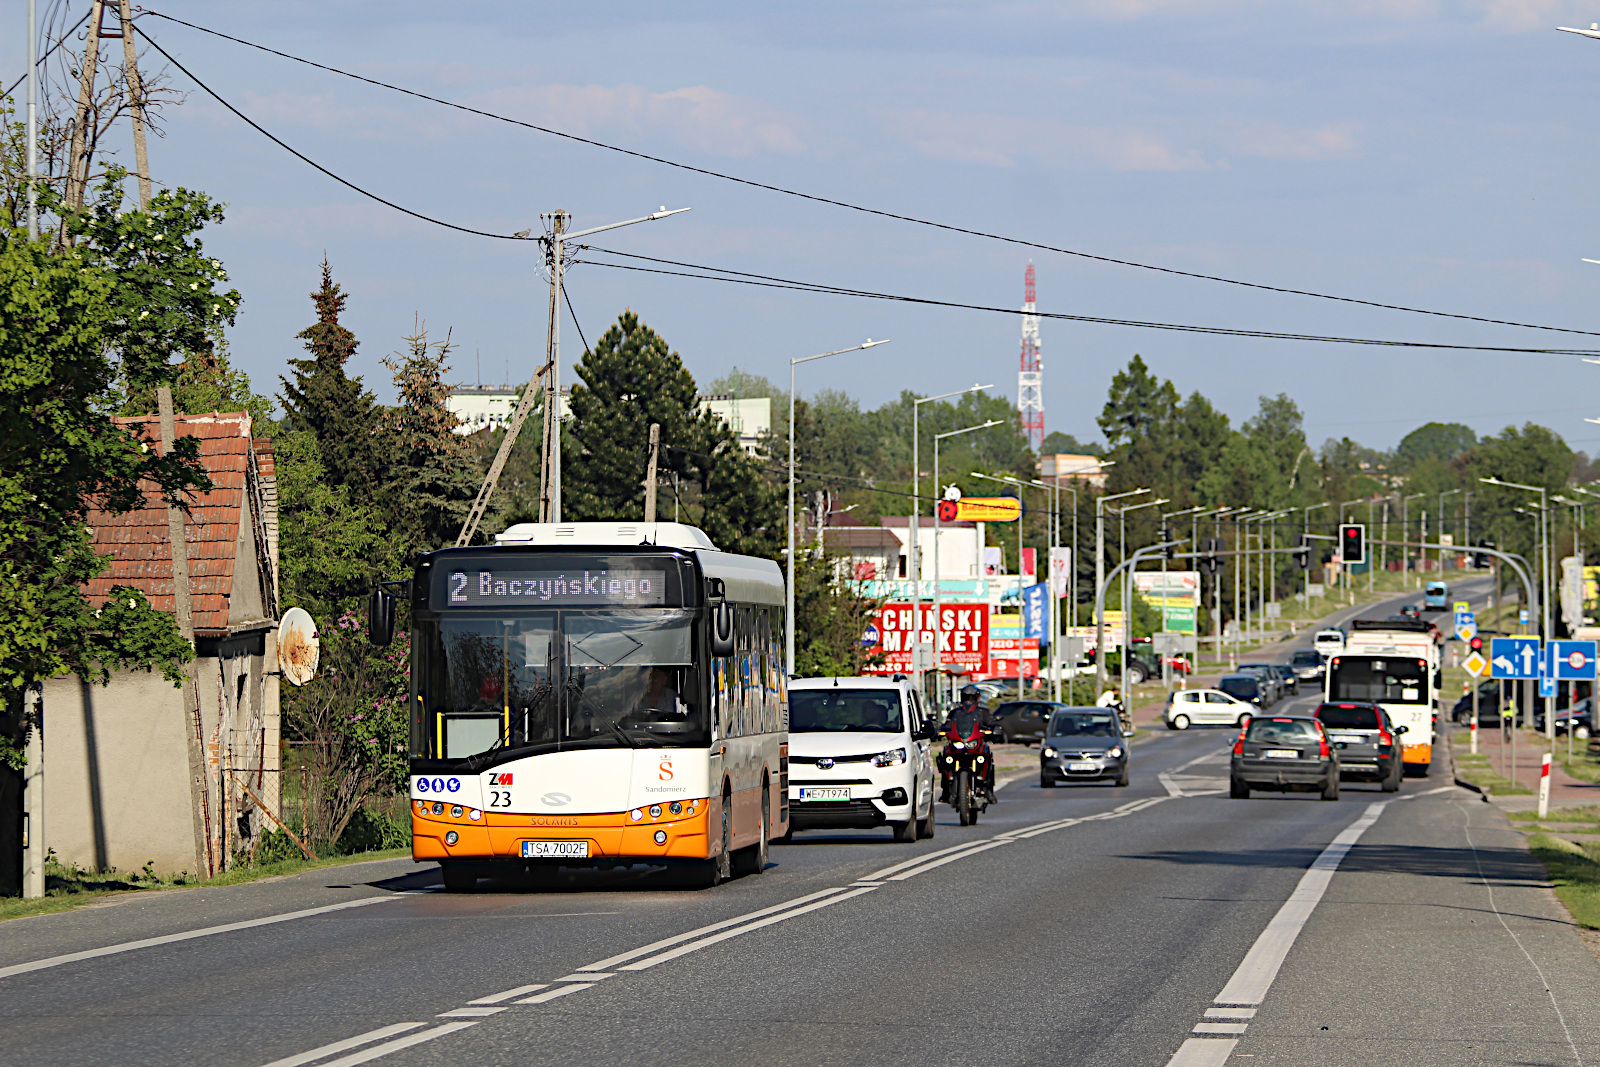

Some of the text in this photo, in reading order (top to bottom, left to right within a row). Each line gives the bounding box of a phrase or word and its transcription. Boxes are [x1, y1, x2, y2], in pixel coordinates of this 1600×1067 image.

[451, 571, 651, 601] 2 Baczyńskiego
[873, 581, 936, 597] APTEKA
[882, 604, 982, 631] CHIŃSKI
[882, 631, 982, 652] MARKET
[1410, 712, 1422, 722] 27
[645, 785, 687, 793] Sandomierz
[806, 789, 848, 799] WE 7T974
[490, 791, 512, 808] 23
[530, 817, 578, 826] SOLARIS
[529, 843, 586, 854] TSA 7002F
